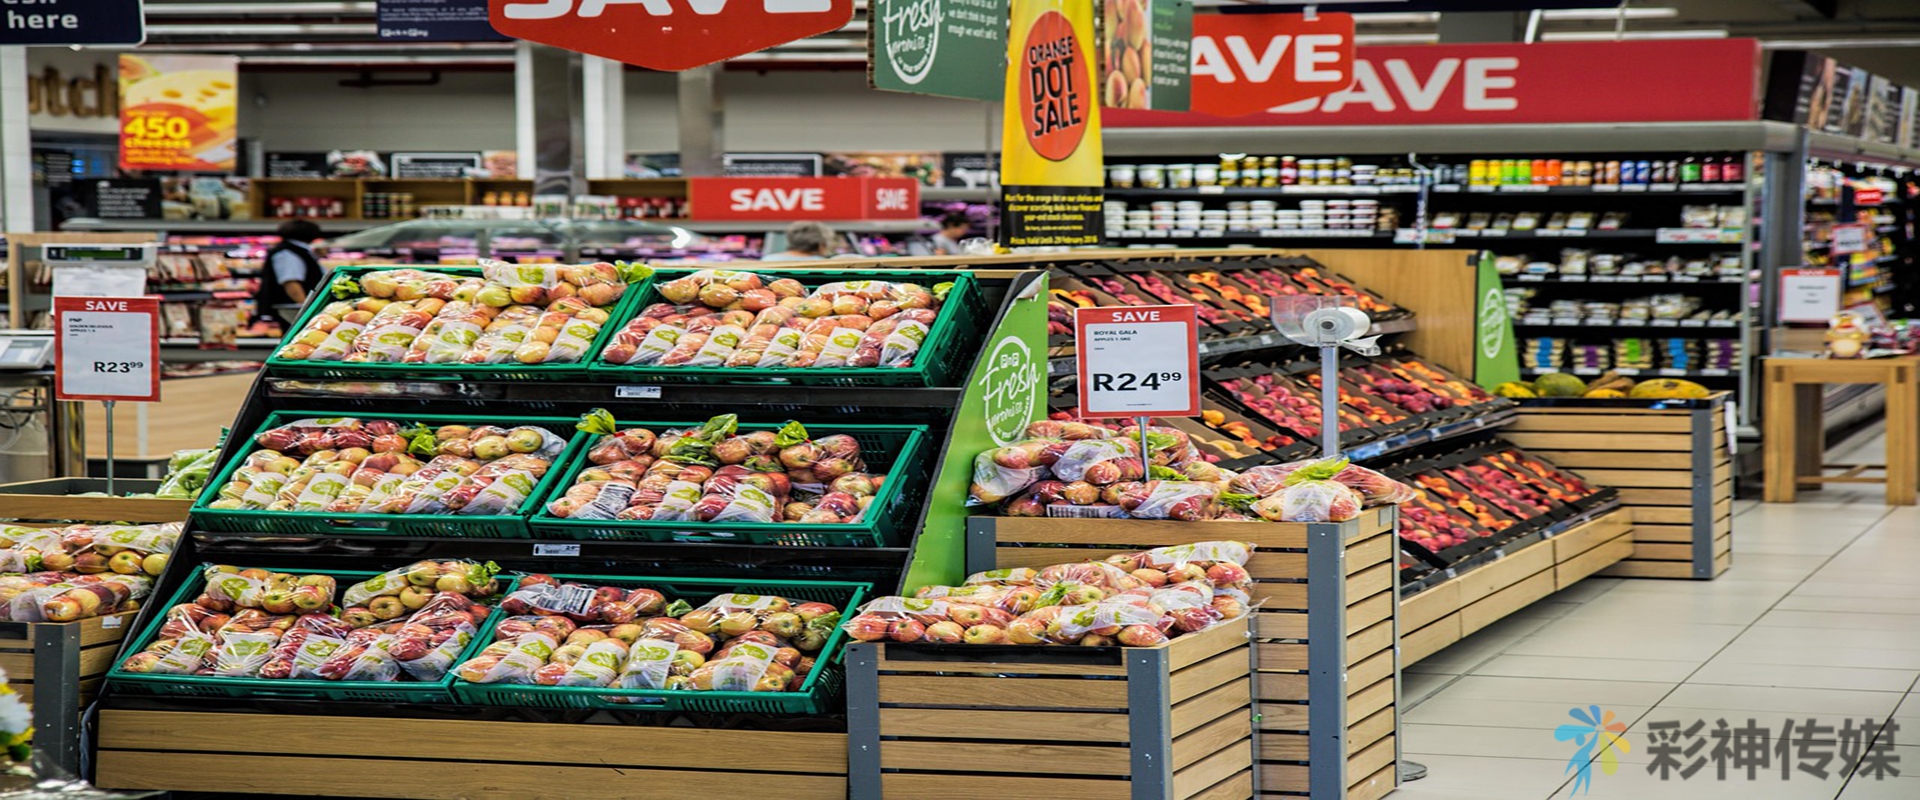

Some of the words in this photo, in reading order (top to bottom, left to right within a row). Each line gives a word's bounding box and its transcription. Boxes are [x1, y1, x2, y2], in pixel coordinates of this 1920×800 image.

[7, 9, 79, 29] here
[1029, 36, 1073, 65] ORANGE
[1190, 34, 1344, 83] AVE
[1031, 56, 1073, 103] DOT
[1267, 57, 1520, 114] AVE
[124, 116, 190, 139] 450
[1034, 94, 1082, 137] SALE
[729, 188, 825, 211] SAVE
[875, 187, 919, 211] SAVE
[85, 300, 128, 311] SAVE
[1112, 310, 1160, 322] SAVE
[979, 347, 1041, 408] Fresh
